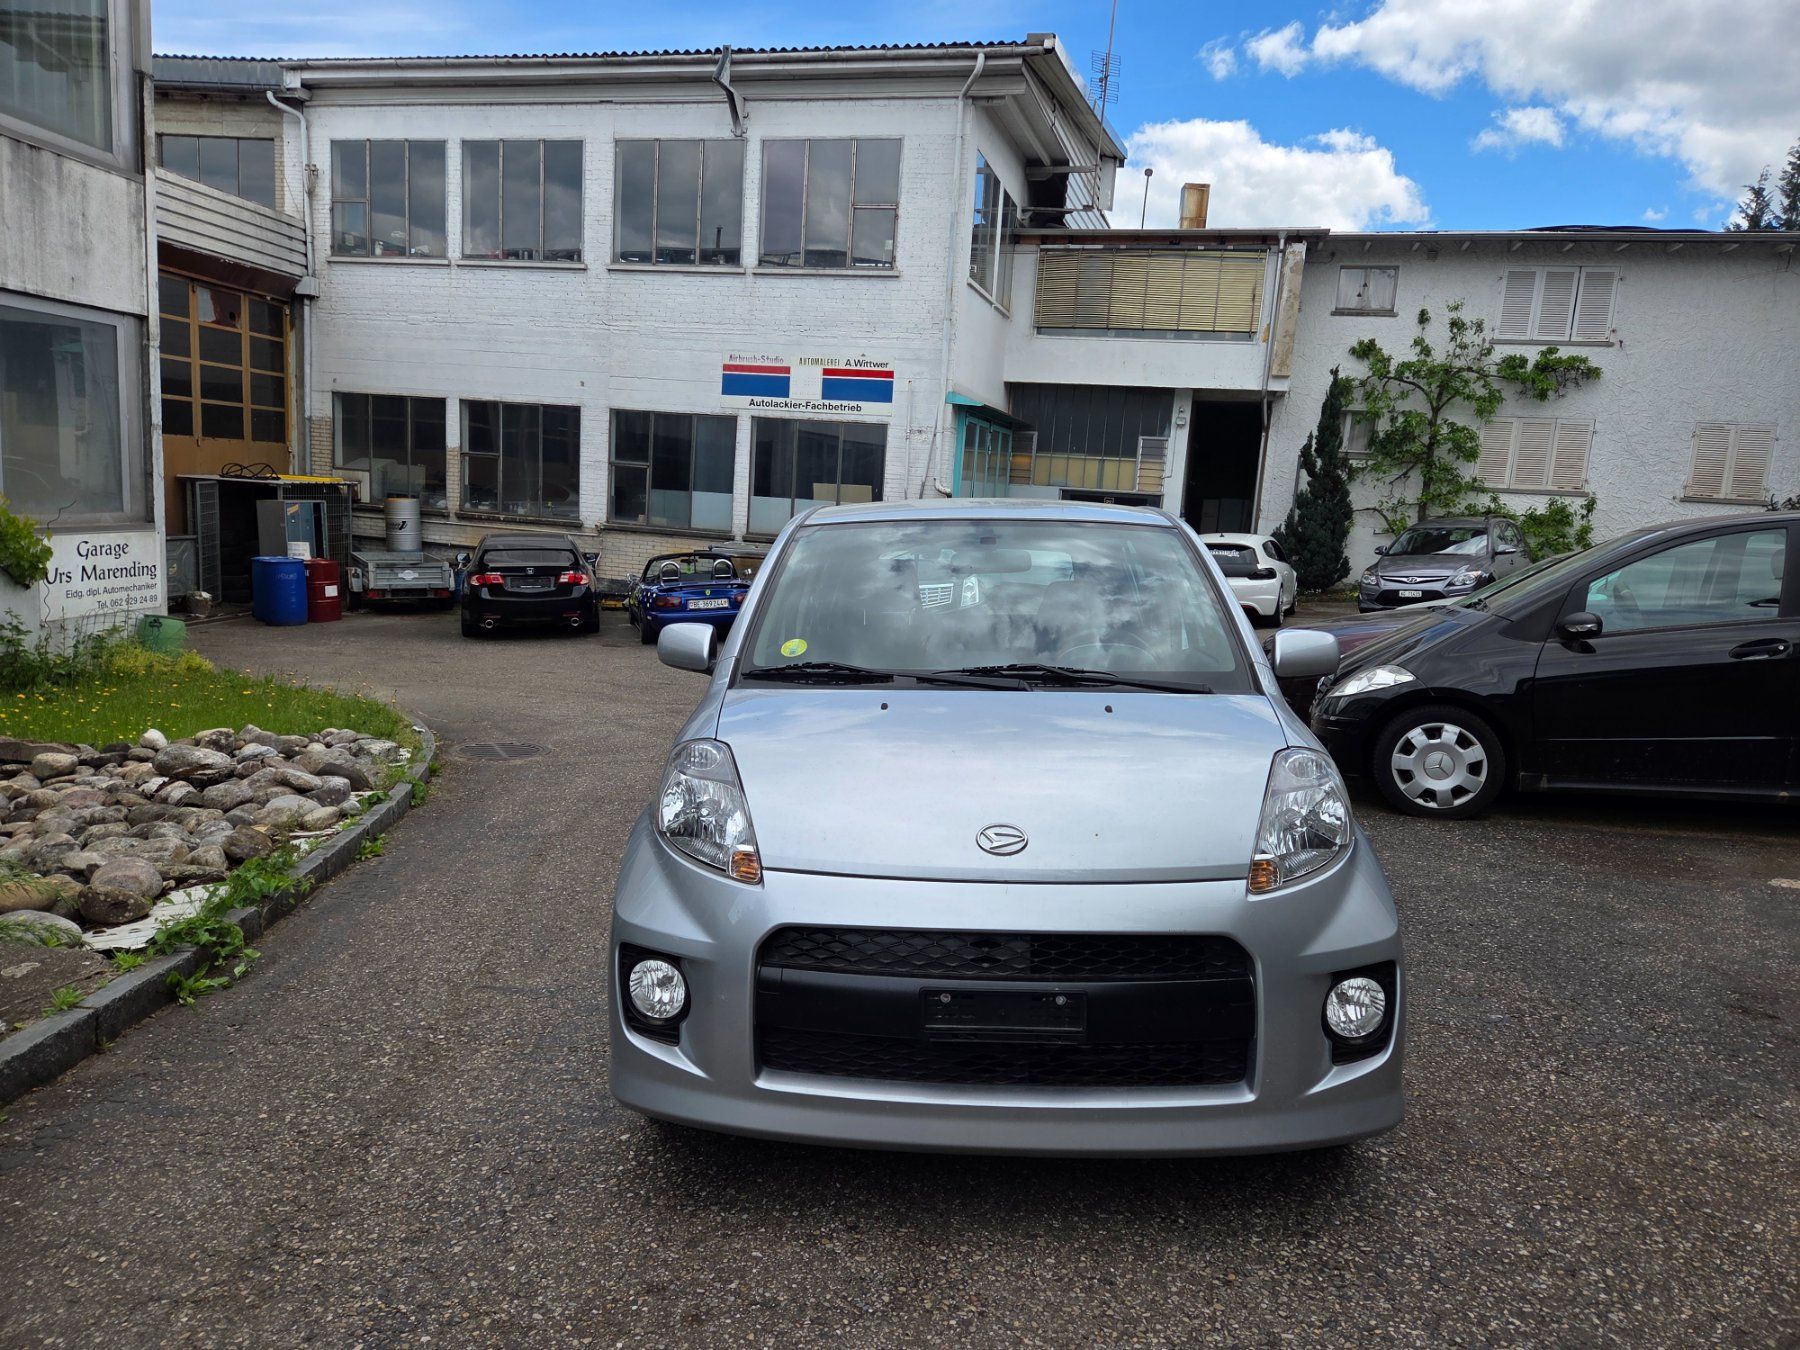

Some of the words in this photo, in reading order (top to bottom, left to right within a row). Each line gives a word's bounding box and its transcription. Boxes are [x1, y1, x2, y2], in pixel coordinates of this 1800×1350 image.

[728, 354, 784, 365] Airbrush-Studio
[748, 398, 862, 413] Autolackier-Fachbetrieb
[77, 541, 129, 560] Garage
[46, 567, 72, 585] Urs
[80, 561, 157, 582] Marending
[102, 582, 157, 595] Automechaniker
[97, 600, 109, 609] Tel.
[110, 598, 123, 608] 062
[140, 595, 148, 604] 24
